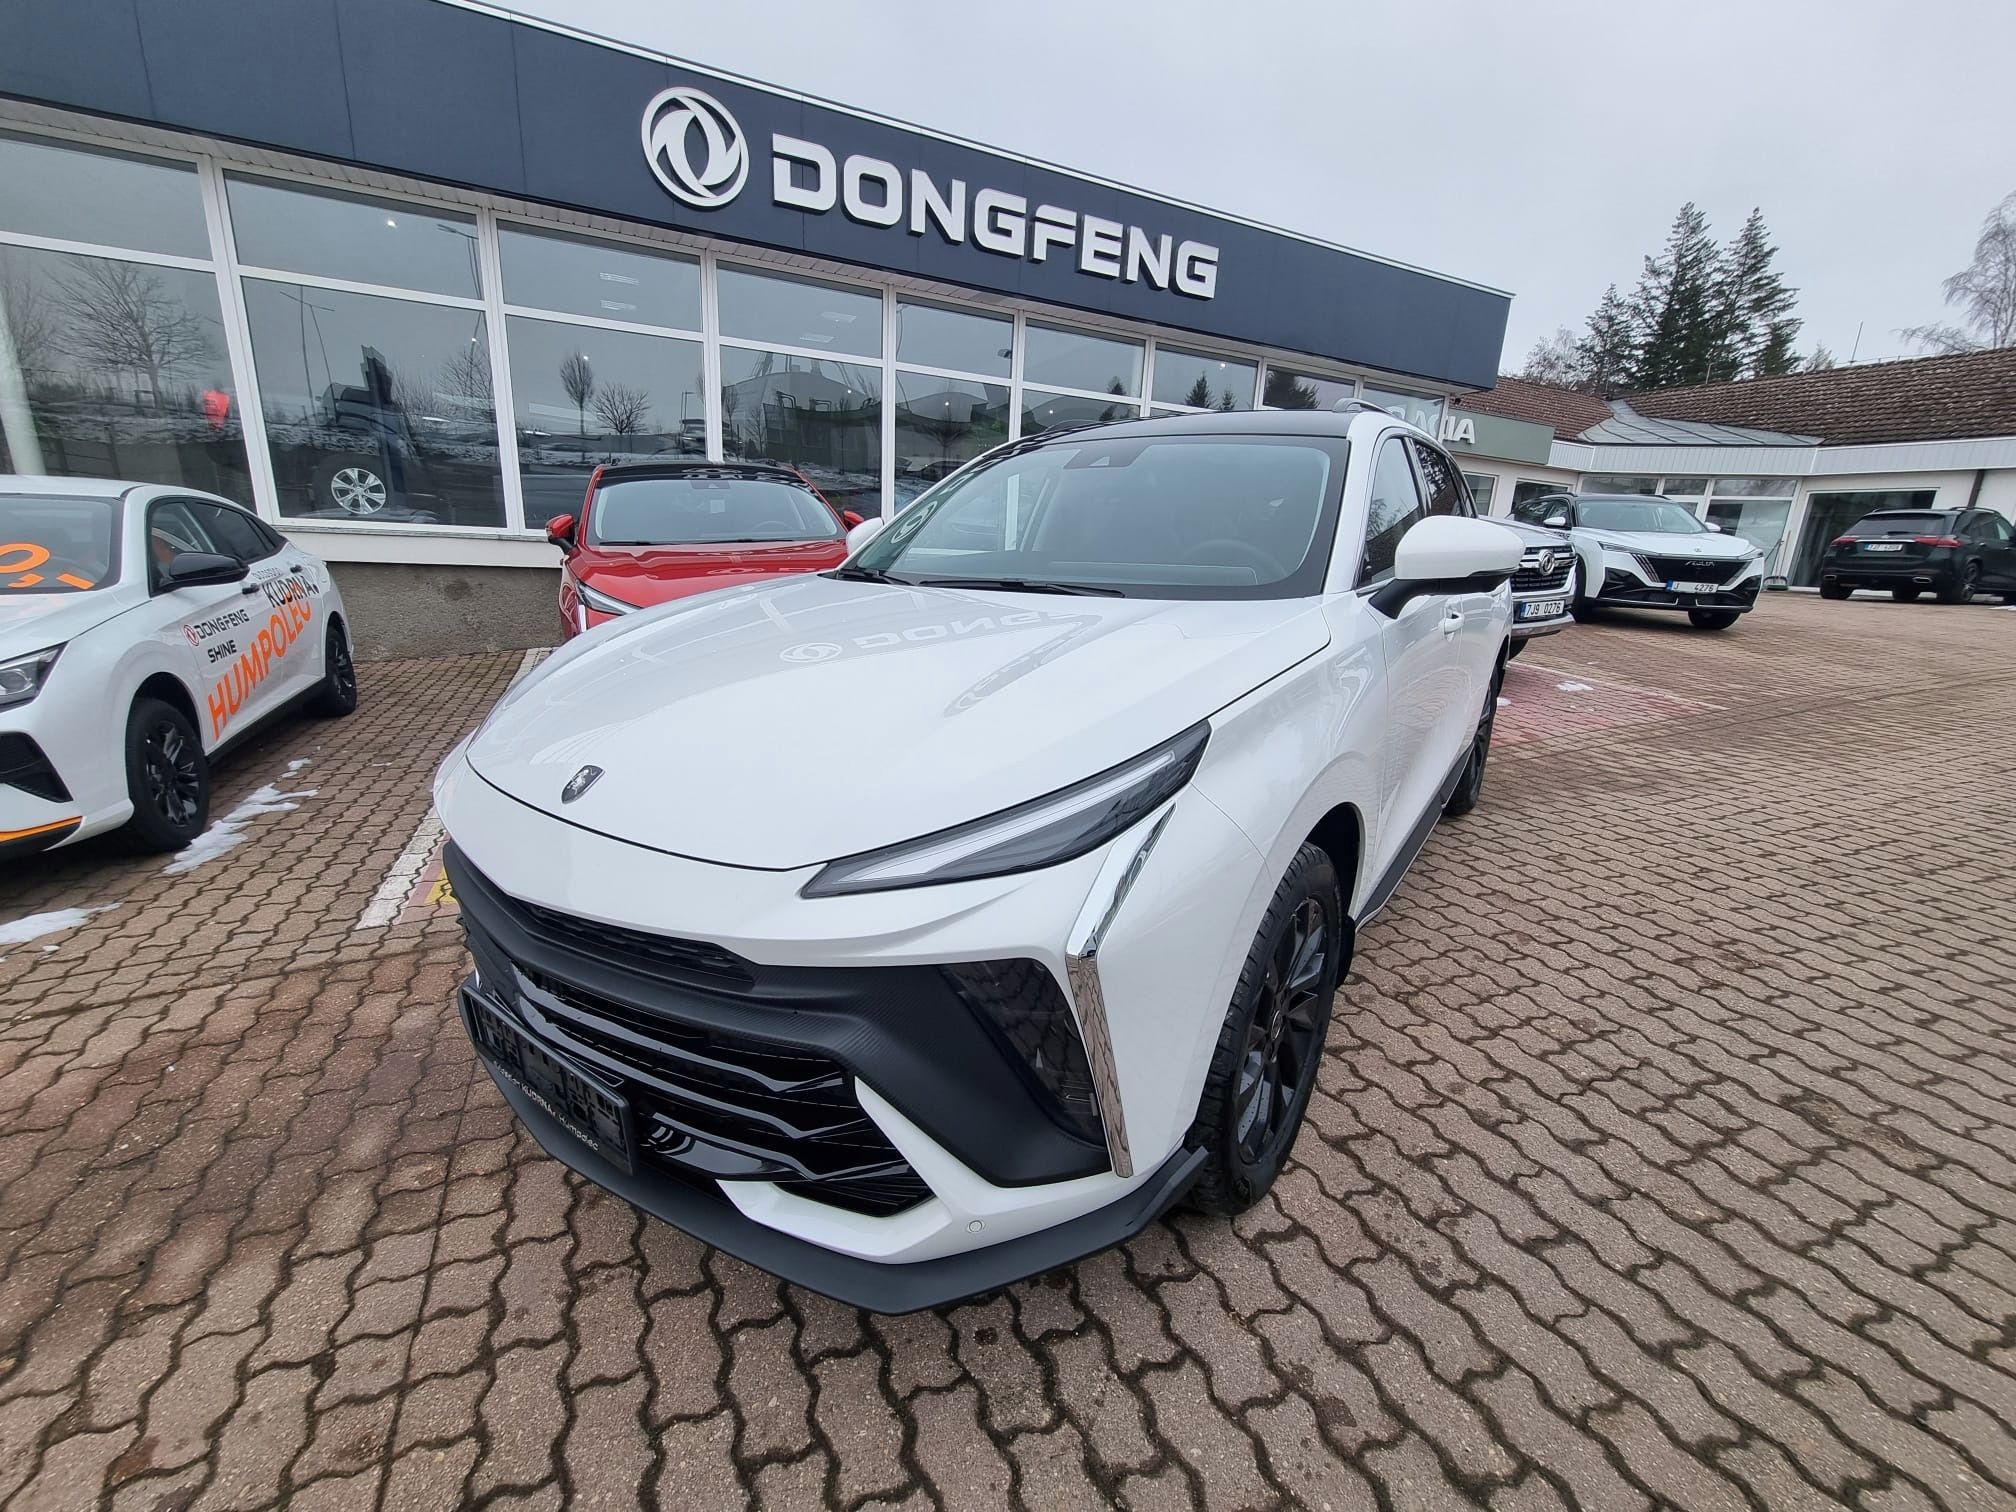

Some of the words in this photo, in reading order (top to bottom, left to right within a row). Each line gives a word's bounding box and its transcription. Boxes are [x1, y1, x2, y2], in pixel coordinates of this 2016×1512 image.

[773, 133, 1219, 299] DONGFENG
[194, 609, 250, 640] DONGFENG
[1526, 603, 1540, 616] 7J9
[1543, 602, 1561, 614] 0276
[207, 584, 312, 741] HUMPOLEC
[208, 639, 237, 663] SHINE
